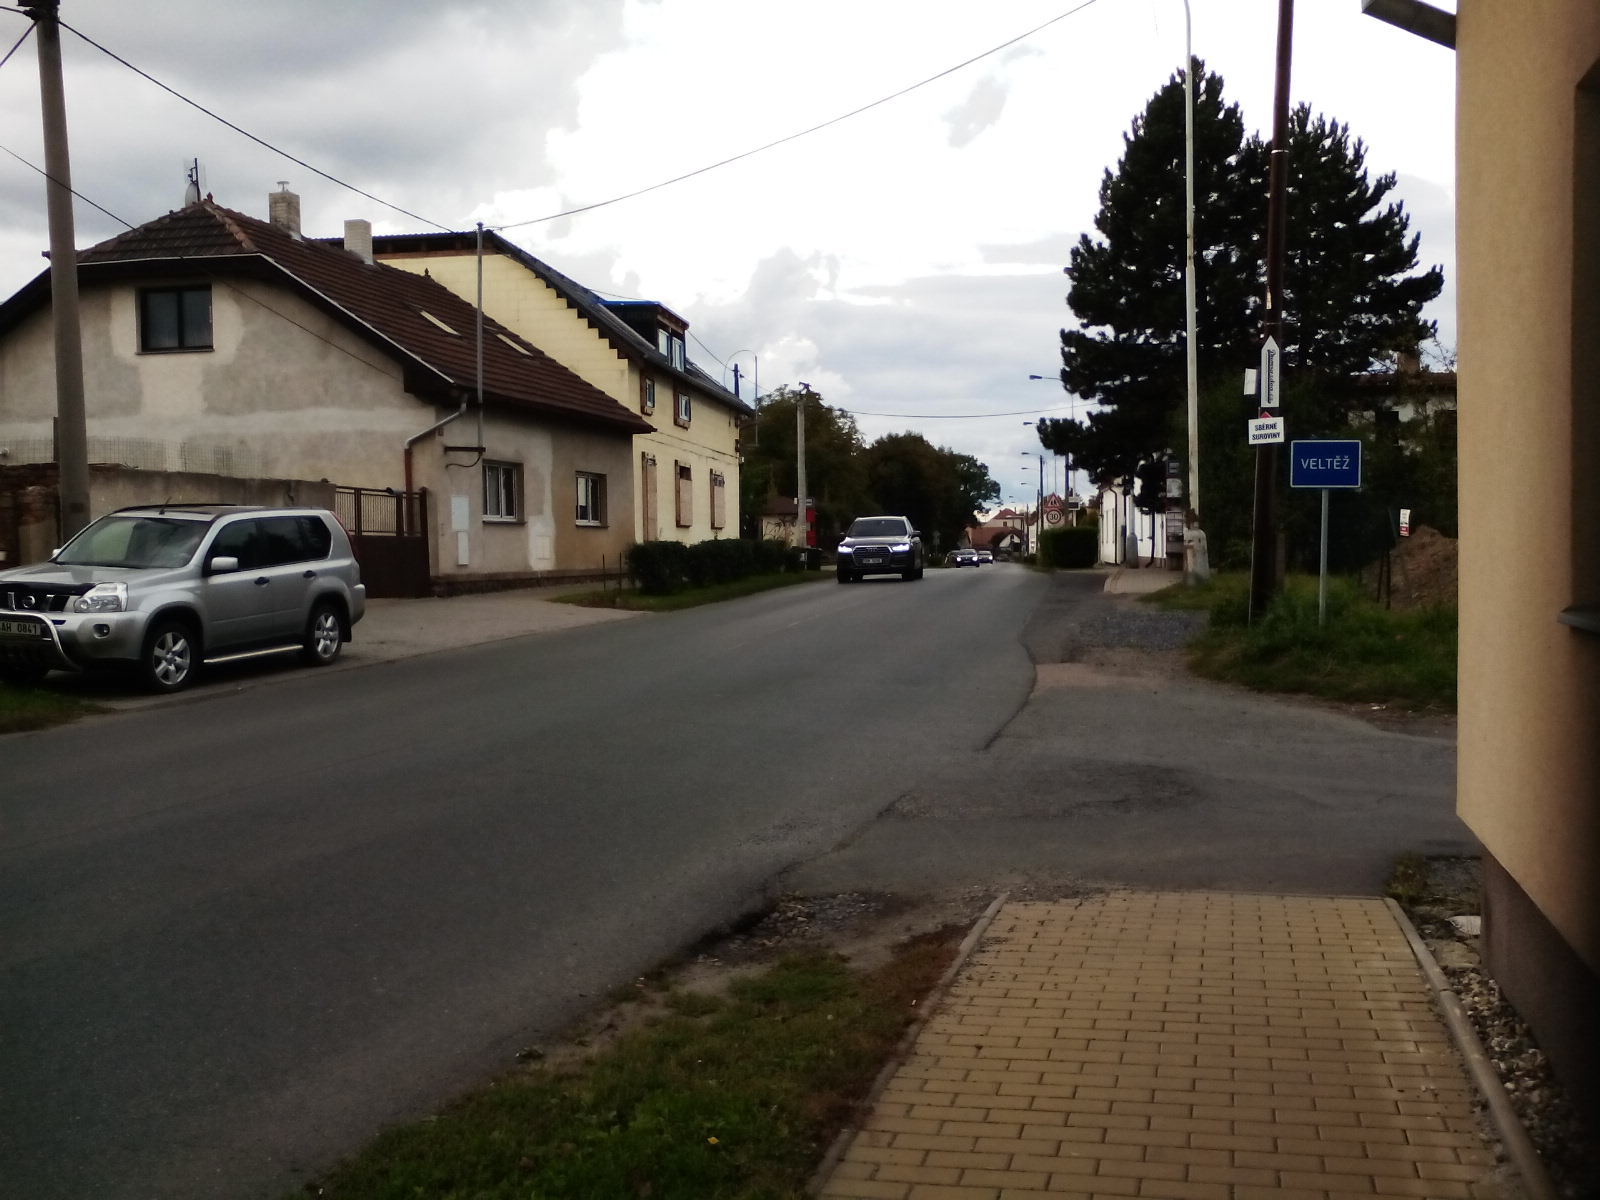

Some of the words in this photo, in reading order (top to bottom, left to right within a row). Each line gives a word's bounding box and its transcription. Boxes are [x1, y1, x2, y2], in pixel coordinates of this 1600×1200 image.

[1252, 432, 1280, 440] SUROVINY
[1301, 456, 1350, 469] VELTĚŽ
[0, 622, 11, 632] AH
[17, 623, 37, 634] 0841
